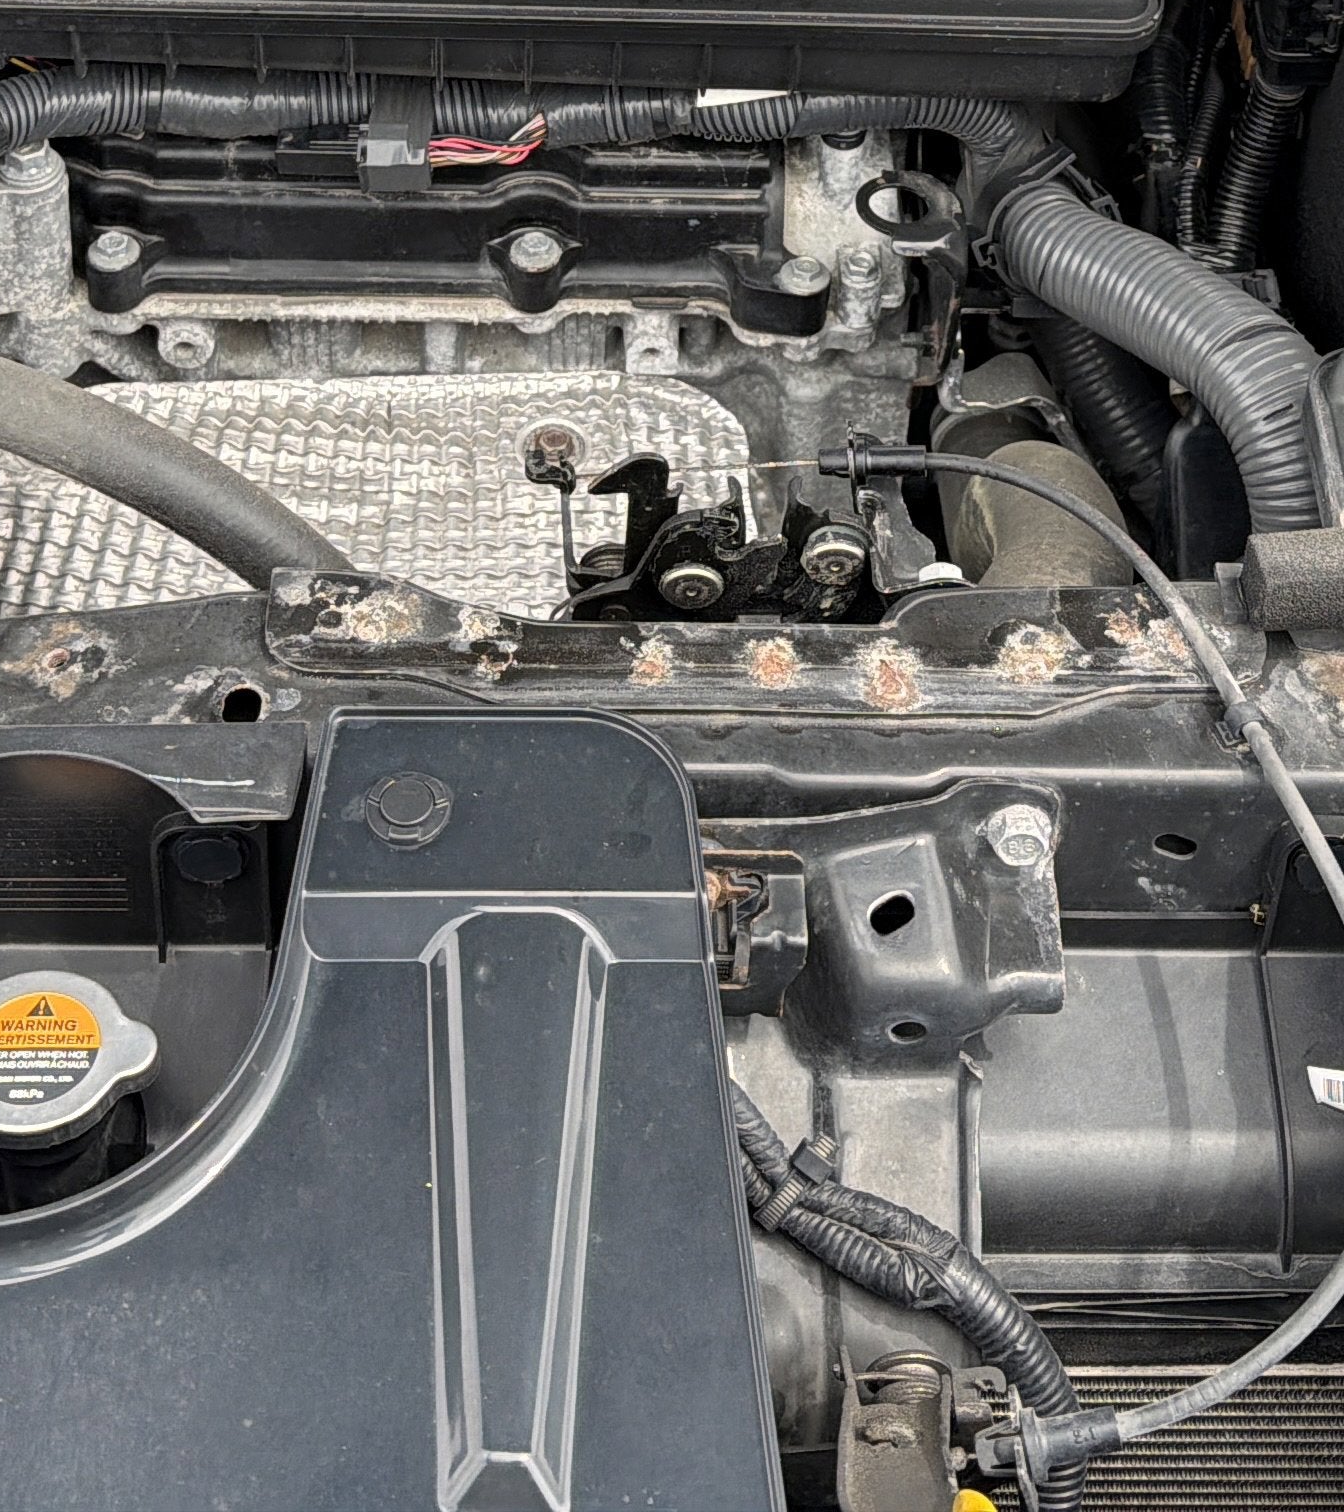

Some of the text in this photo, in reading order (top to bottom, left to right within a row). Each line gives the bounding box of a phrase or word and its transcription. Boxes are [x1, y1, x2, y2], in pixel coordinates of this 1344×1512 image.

[0, 1019, 78, 1032] WARNING
[9, 1050, 36, 1059] OPEN
[37, 1050, 67, 1059] WHEN
